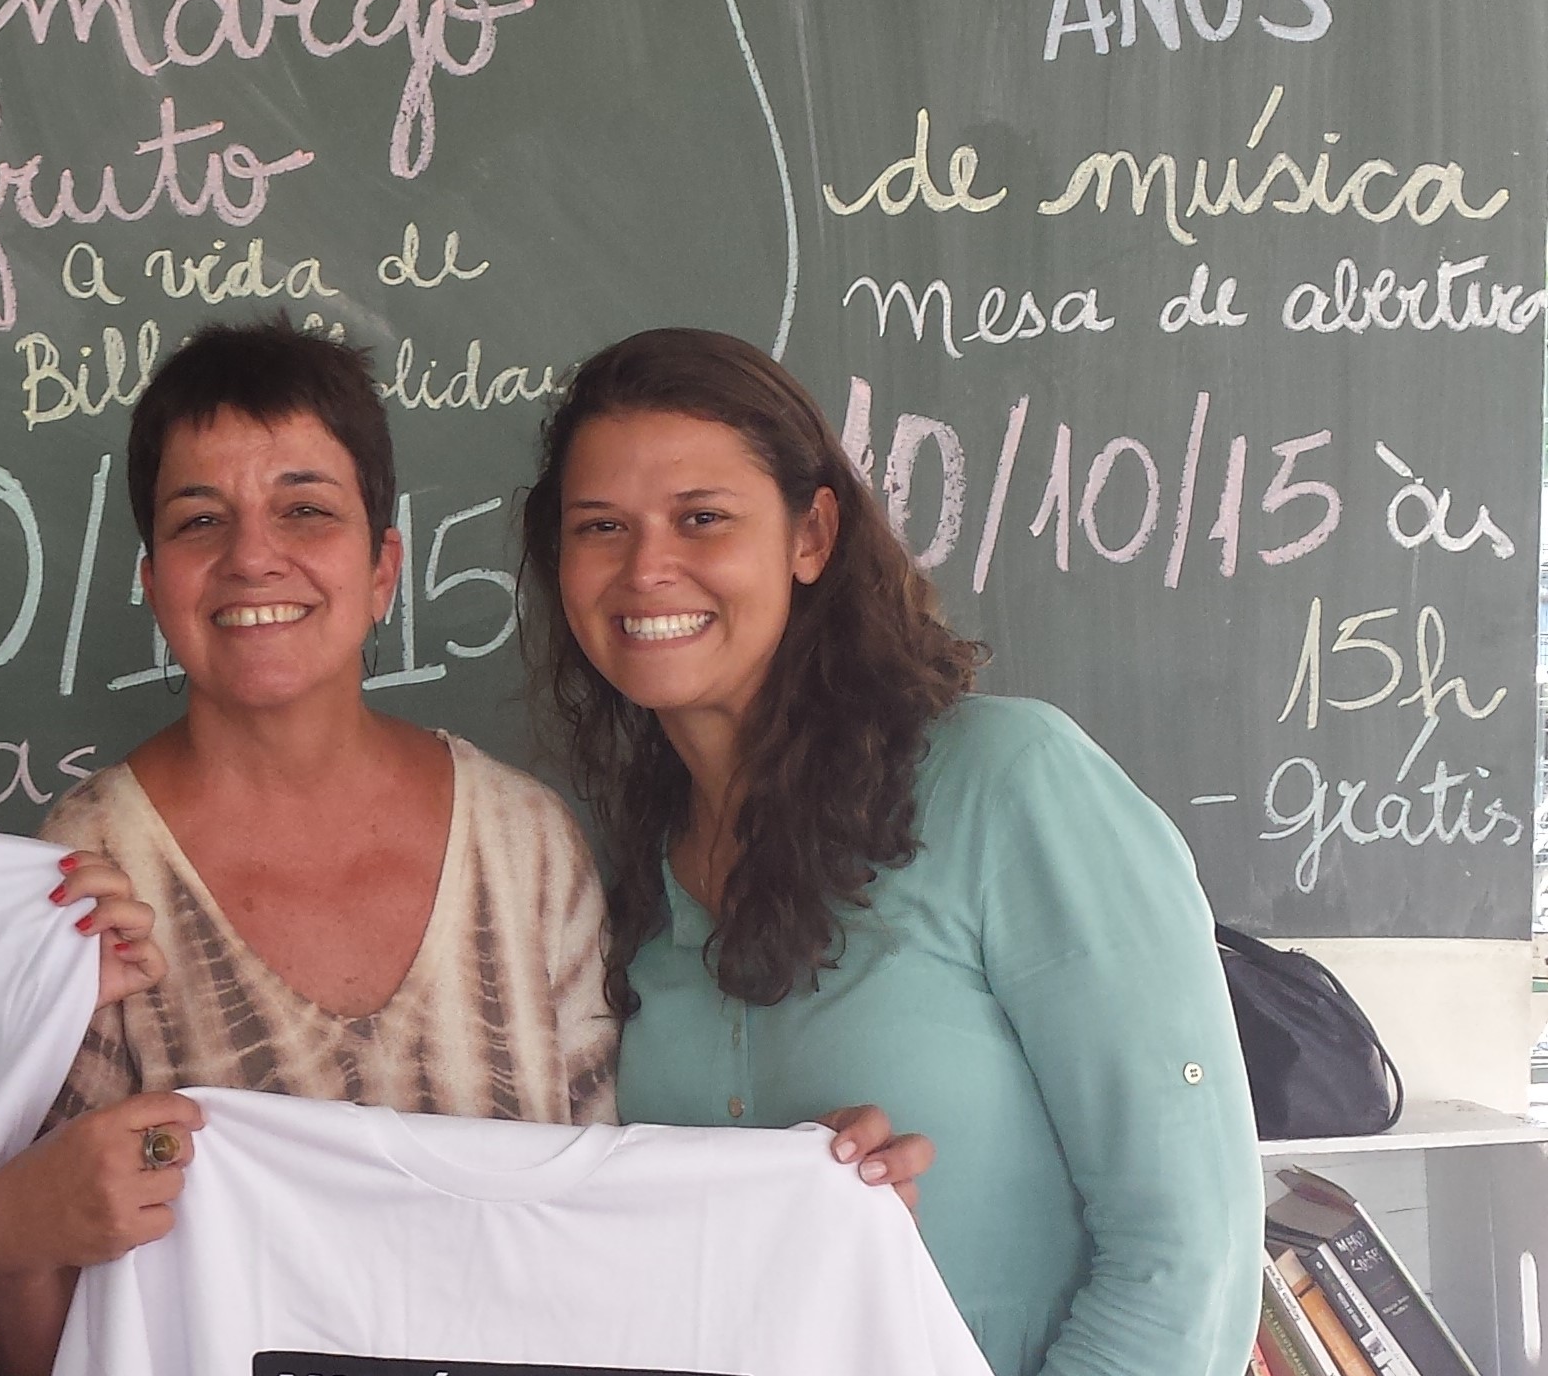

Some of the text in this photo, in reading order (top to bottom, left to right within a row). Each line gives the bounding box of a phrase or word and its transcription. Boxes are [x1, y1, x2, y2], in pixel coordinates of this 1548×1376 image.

[822, 84, 1510, 246] de música
[143, 236, 341, 306] vida
[376, 221, 491, 289] de
[1159, 262, 1249, 335] de
[14, 317, 192, 432] Bill
[1277, 596, 1509, 730] 15h
